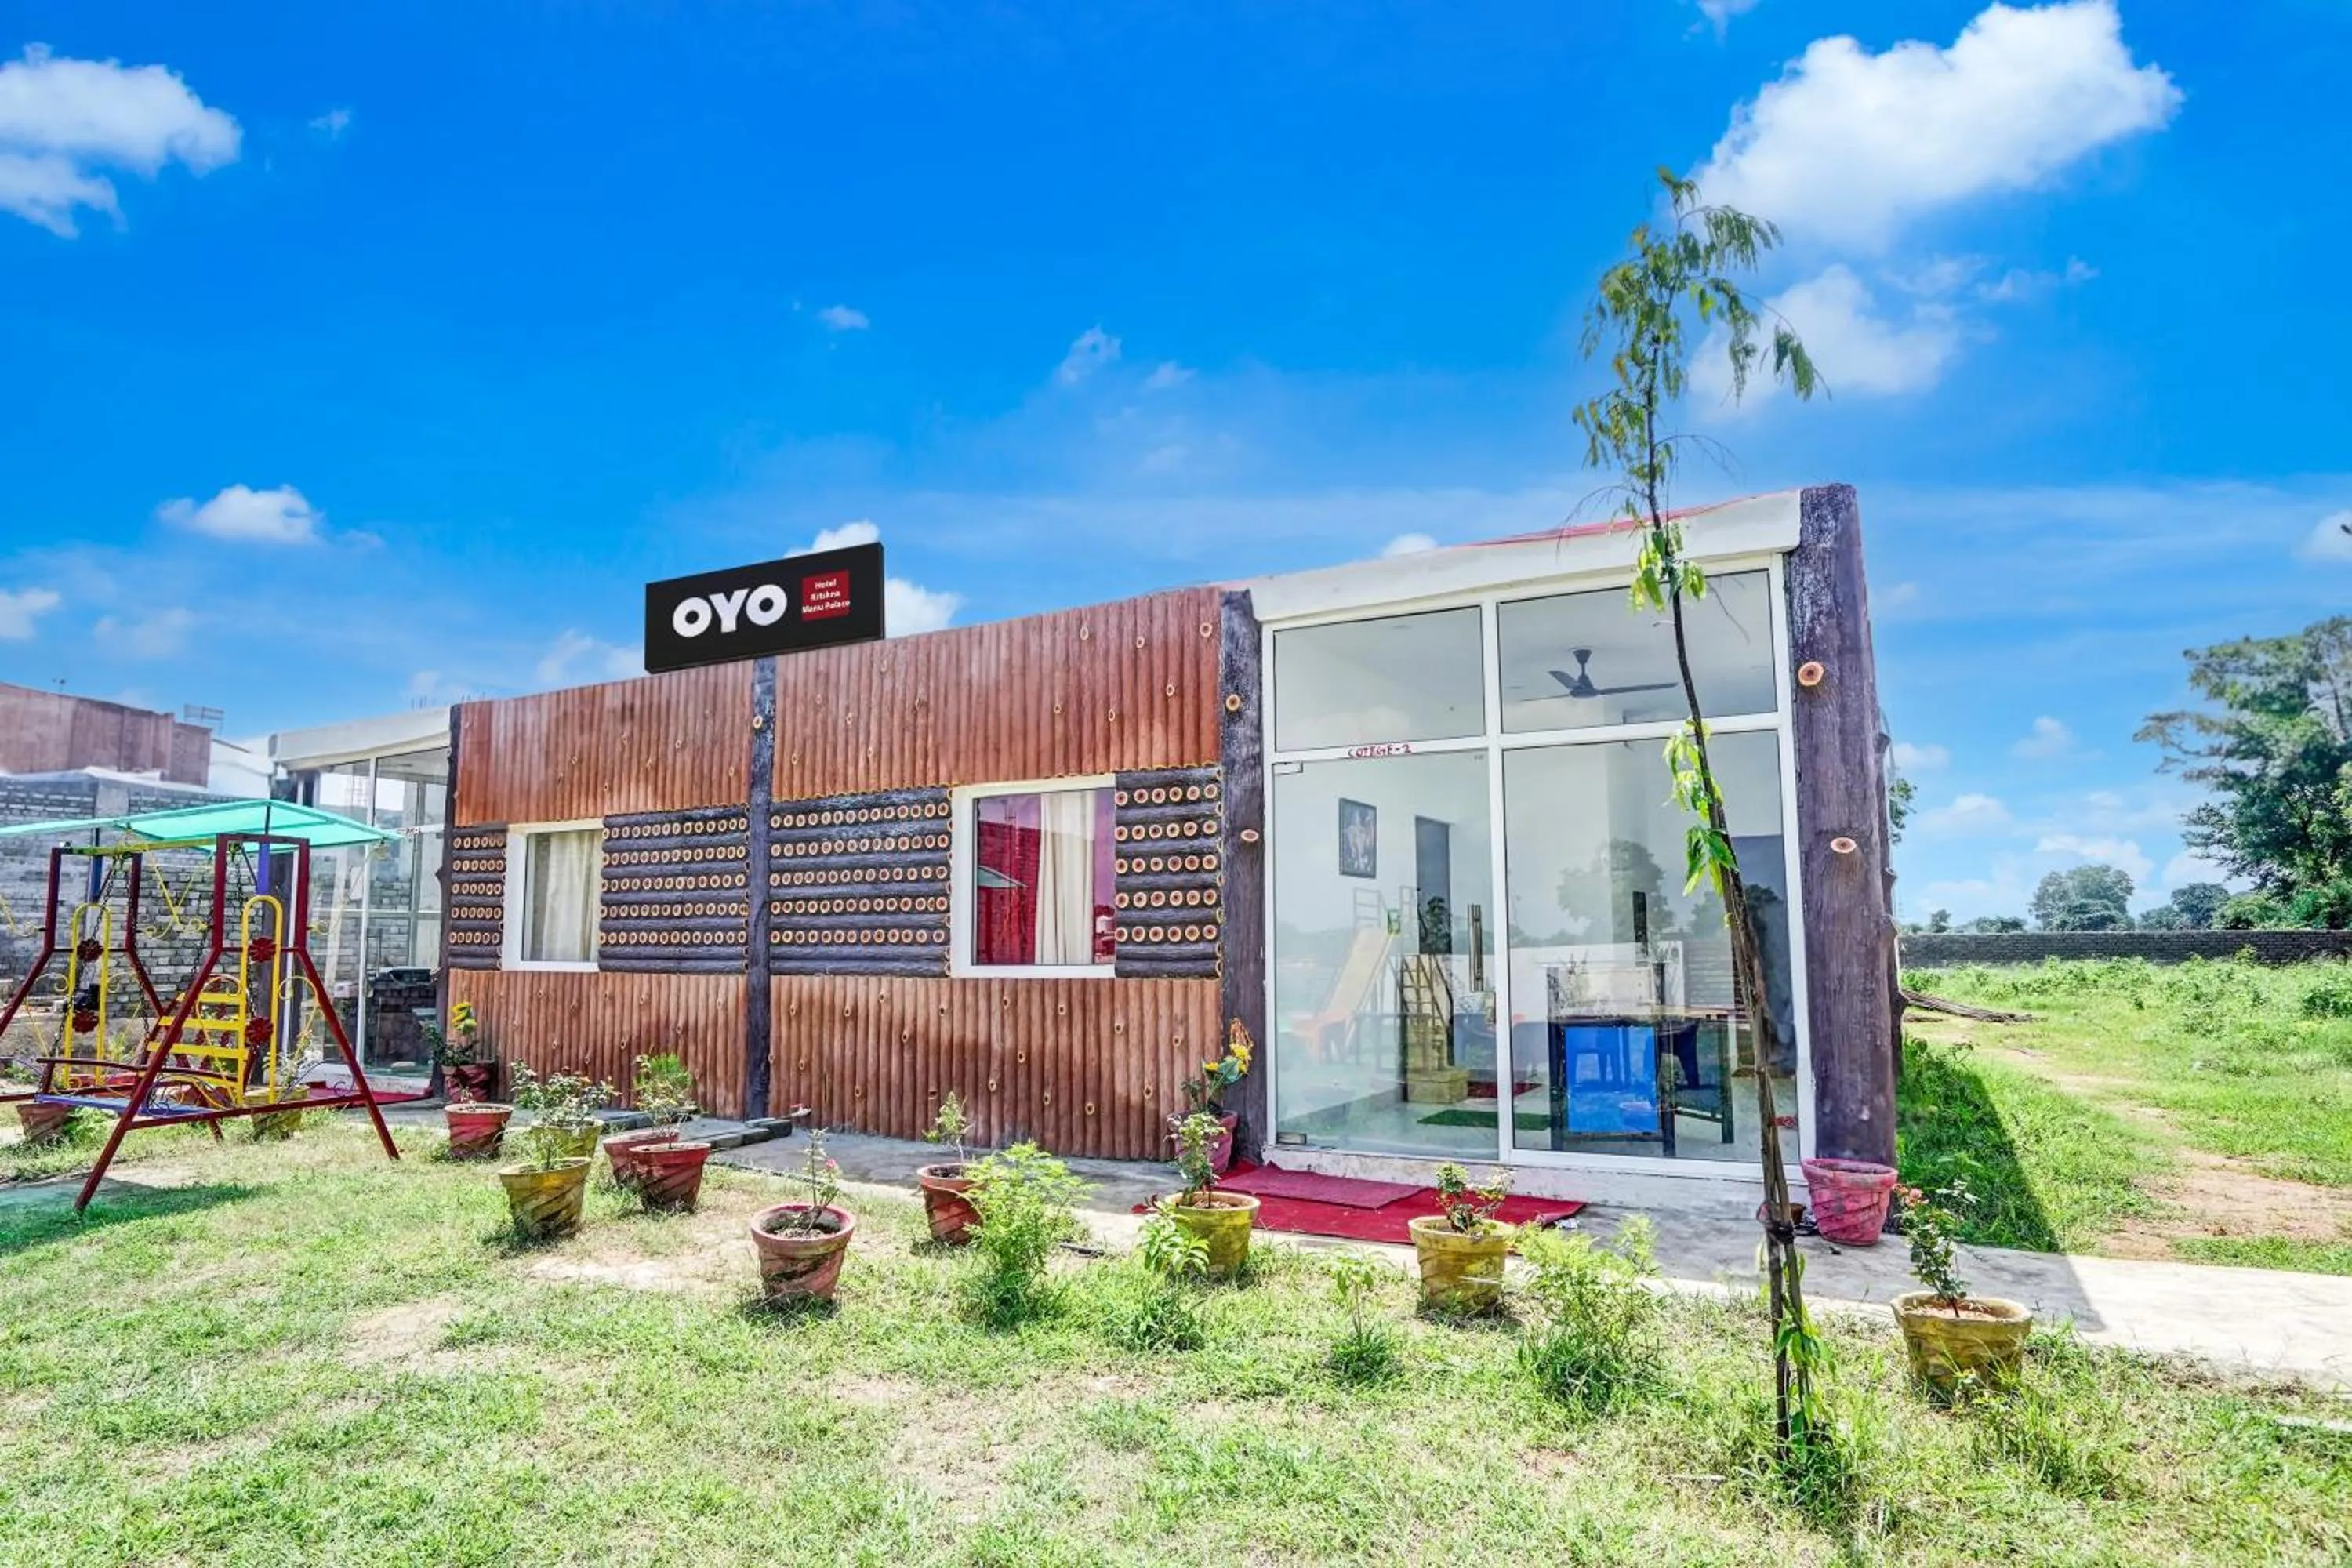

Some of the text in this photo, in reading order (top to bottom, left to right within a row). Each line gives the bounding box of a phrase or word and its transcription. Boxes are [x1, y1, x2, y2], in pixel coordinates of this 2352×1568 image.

[815, 578, 837, 590] Hotel
[673, 583, 787, 638] OYO
[825, 600, 851, 611] Palace
